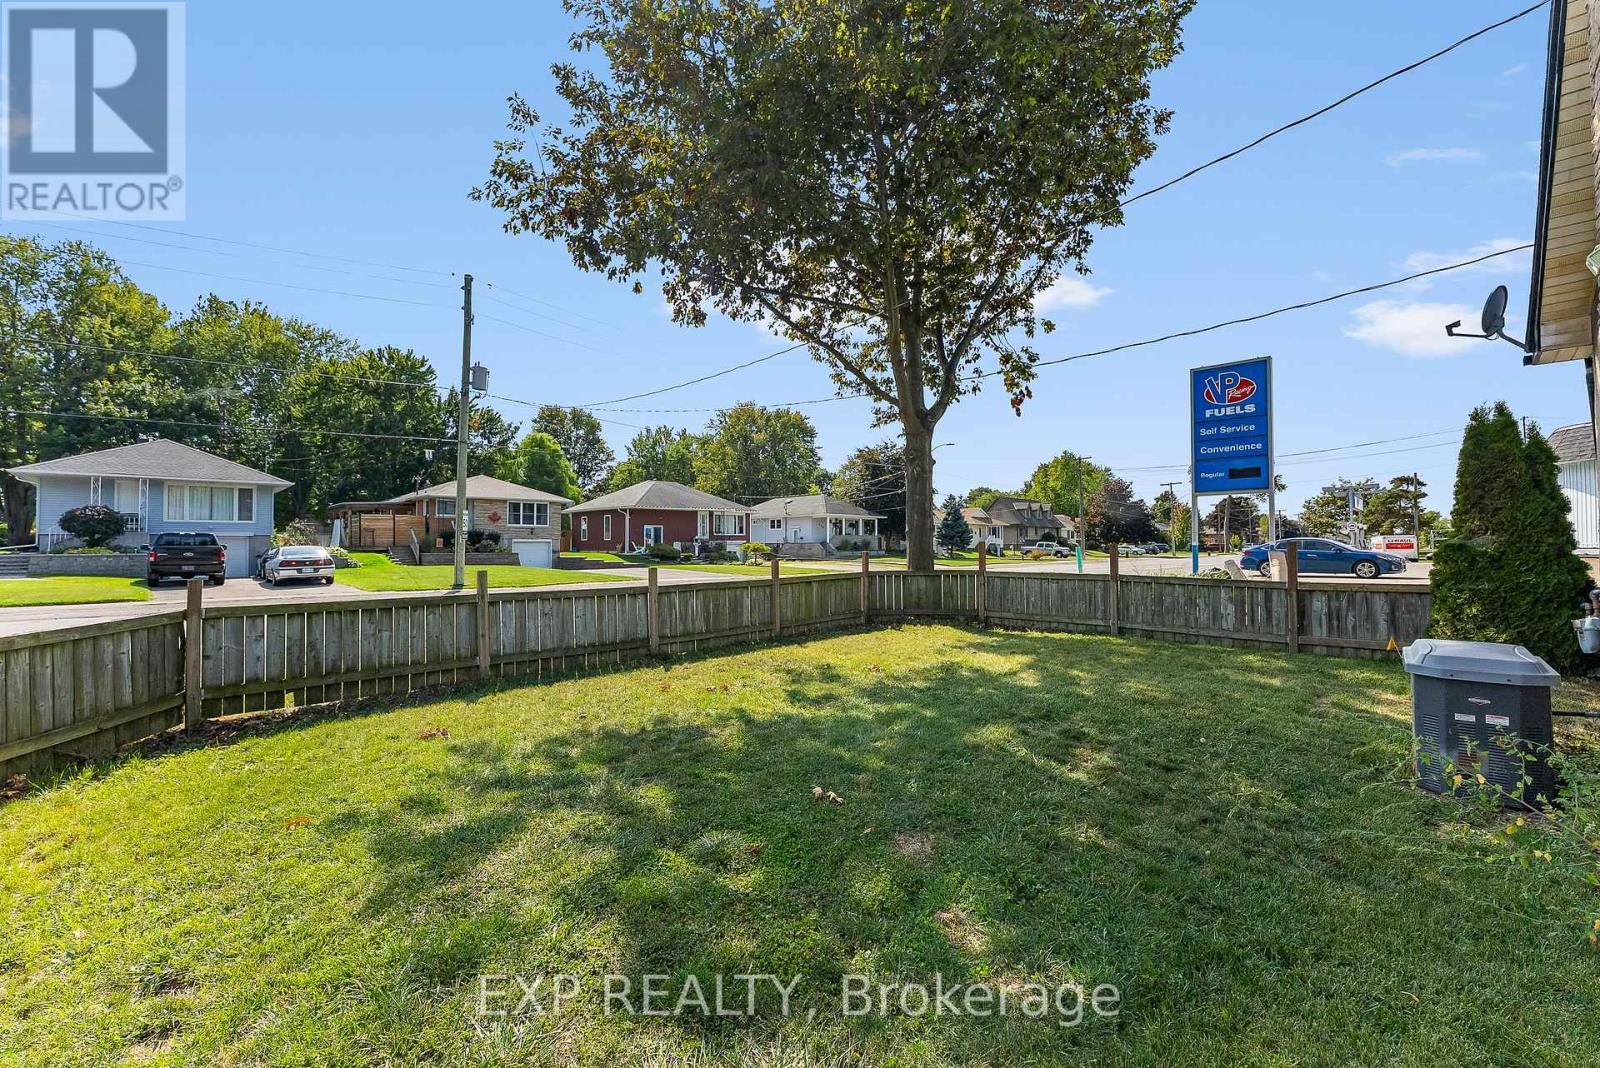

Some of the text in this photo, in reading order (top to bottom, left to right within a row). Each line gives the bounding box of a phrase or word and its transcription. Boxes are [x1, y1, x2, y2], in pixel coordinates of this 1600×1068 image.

[1205, 371, 1240, 404] VP
[1228, 385, 1254, 400] Racing
[1205, 404, 1256, 418] FUELS
[1200, 424, 1255, 436] Self Service
[1200, 442, 1262, 454] Convenience
